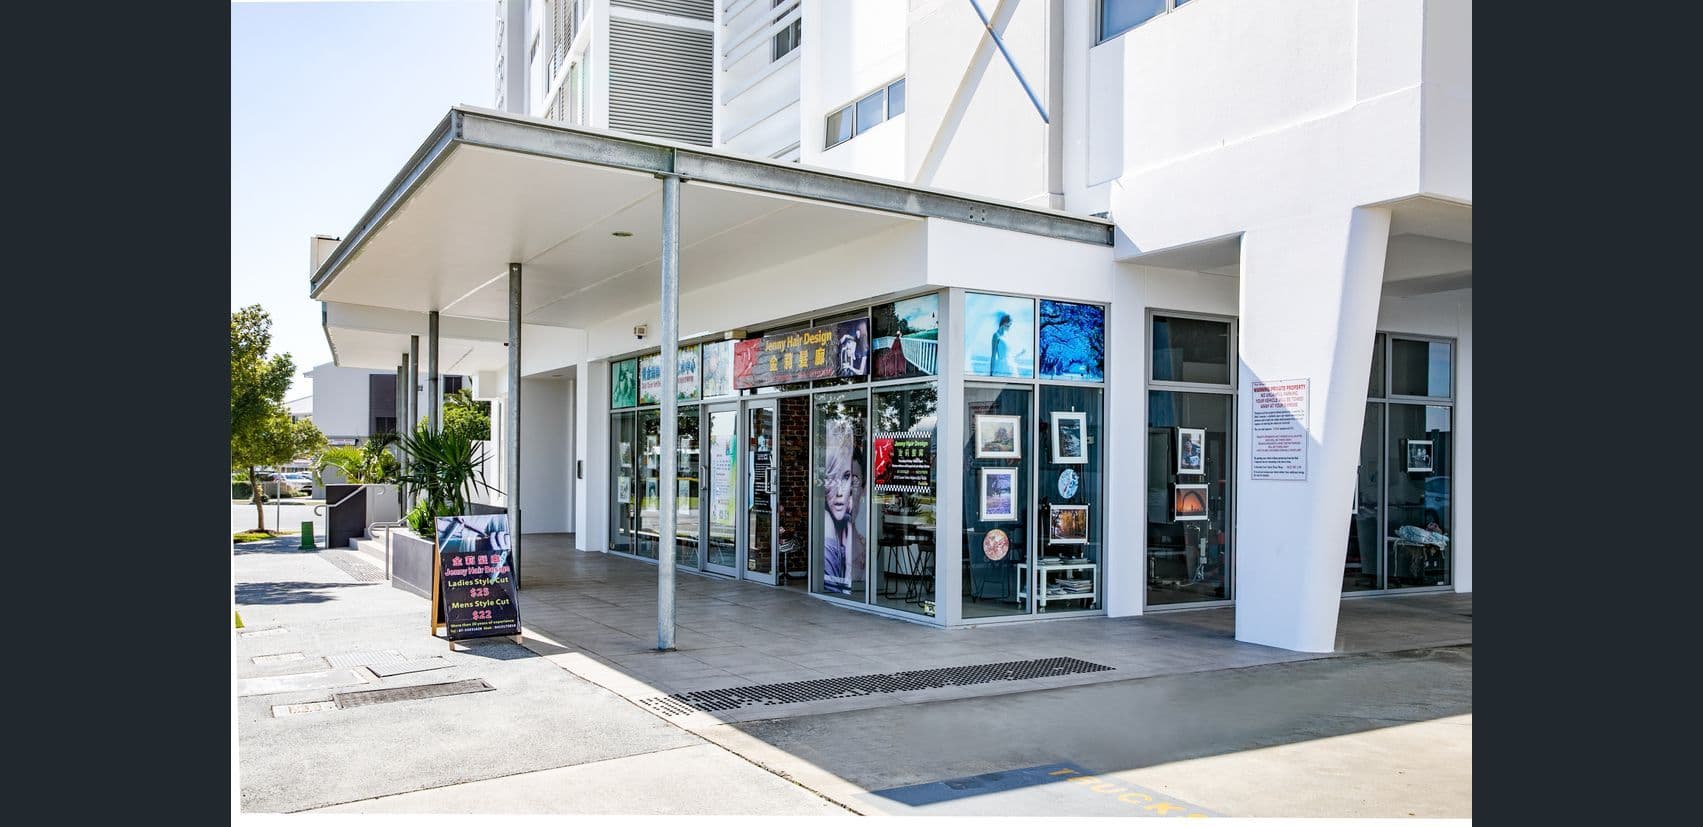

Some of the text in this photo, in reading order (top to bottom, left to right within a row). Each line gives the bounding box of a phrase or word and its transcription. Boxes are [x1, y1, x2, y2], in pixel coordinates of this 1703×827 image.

[765, 329, 832, 352] Jenny Hair Design
[445, 565, 510, 577] Jenny Hair Design
[448, 578, 474, 587] Ladies
[474, 578, 494, 587] Style
[470, 587, 490, 598] $25
[474, 600, 495, 608] Style
[472, 609, 493, 620] $22
